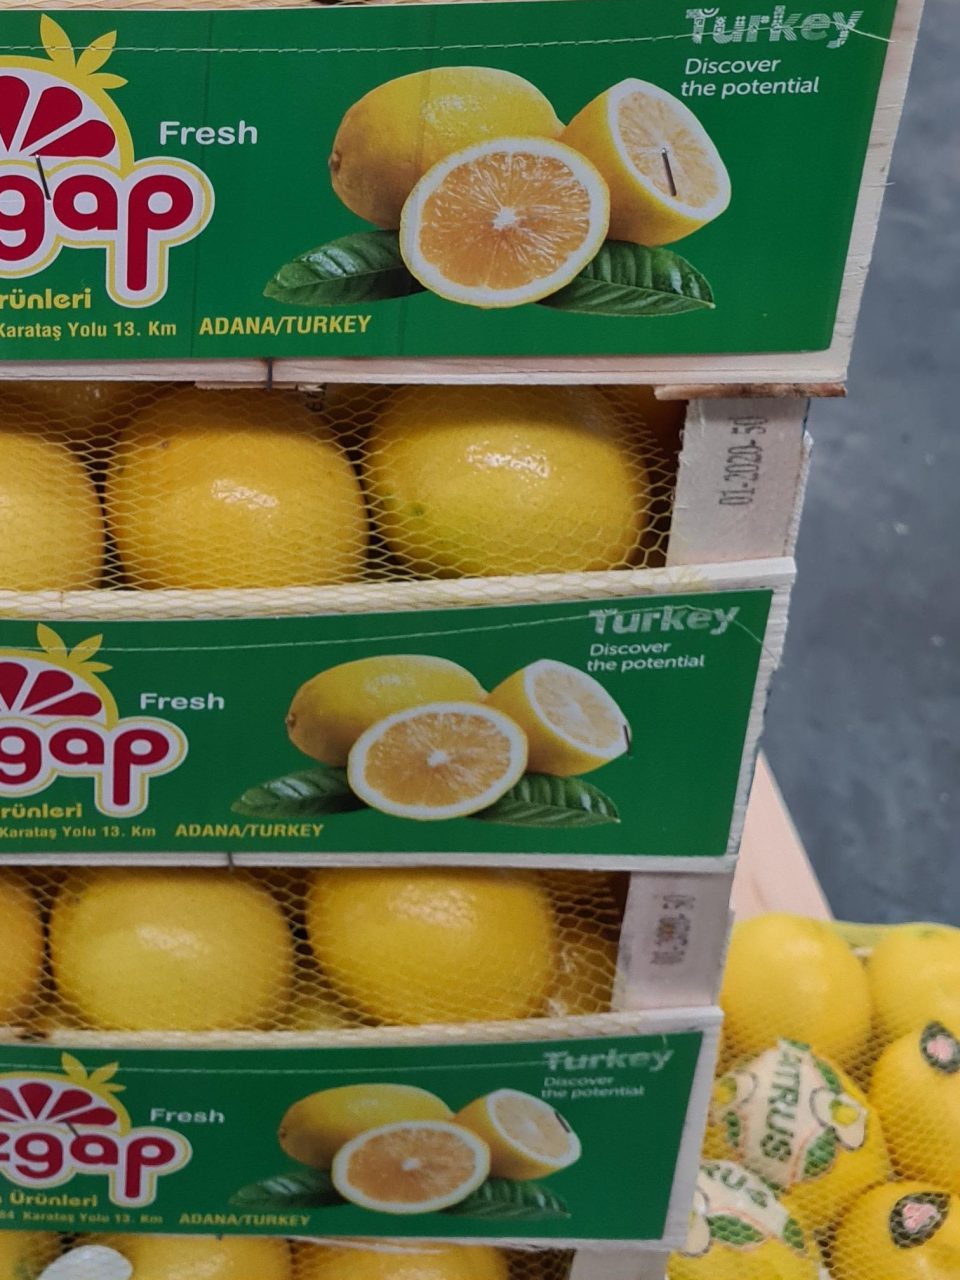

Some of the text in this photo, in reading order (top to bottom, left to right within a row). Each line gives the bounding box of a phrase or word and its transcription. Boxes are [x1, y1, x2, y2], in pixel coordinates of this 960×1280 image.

[686, 5, 864, 49] Turkey
[685, 58, 781, 75] Discover
[681, 76, 820, 99] the potential
[159, 120, 258, 146] Fresh
[67, 323, 107, 337] Yolu
[113, 322, 141, 337] 13.
[148, 322, 177, 336] Km
[199, 315, 372, 336] ADANA/TURKEY
[589, 605, 741, 635] Turkey
[590, 642, 671, 657] Discover
[587, 655, 705, 673] the potential
[140, 693, 225, 710] Fresh
[62, 825, 96, 838] Yolu
[131, 825, 156, 837] Km
[175, 823, 324, 838] ADANA/TURKEY
[543, 1048, 675, 1072] Turkey
[543, 1076, 615, 1087] Discover
[541, 1086, 646, 1100] the potential
[150, 1107, 225, 1123] Fresh
